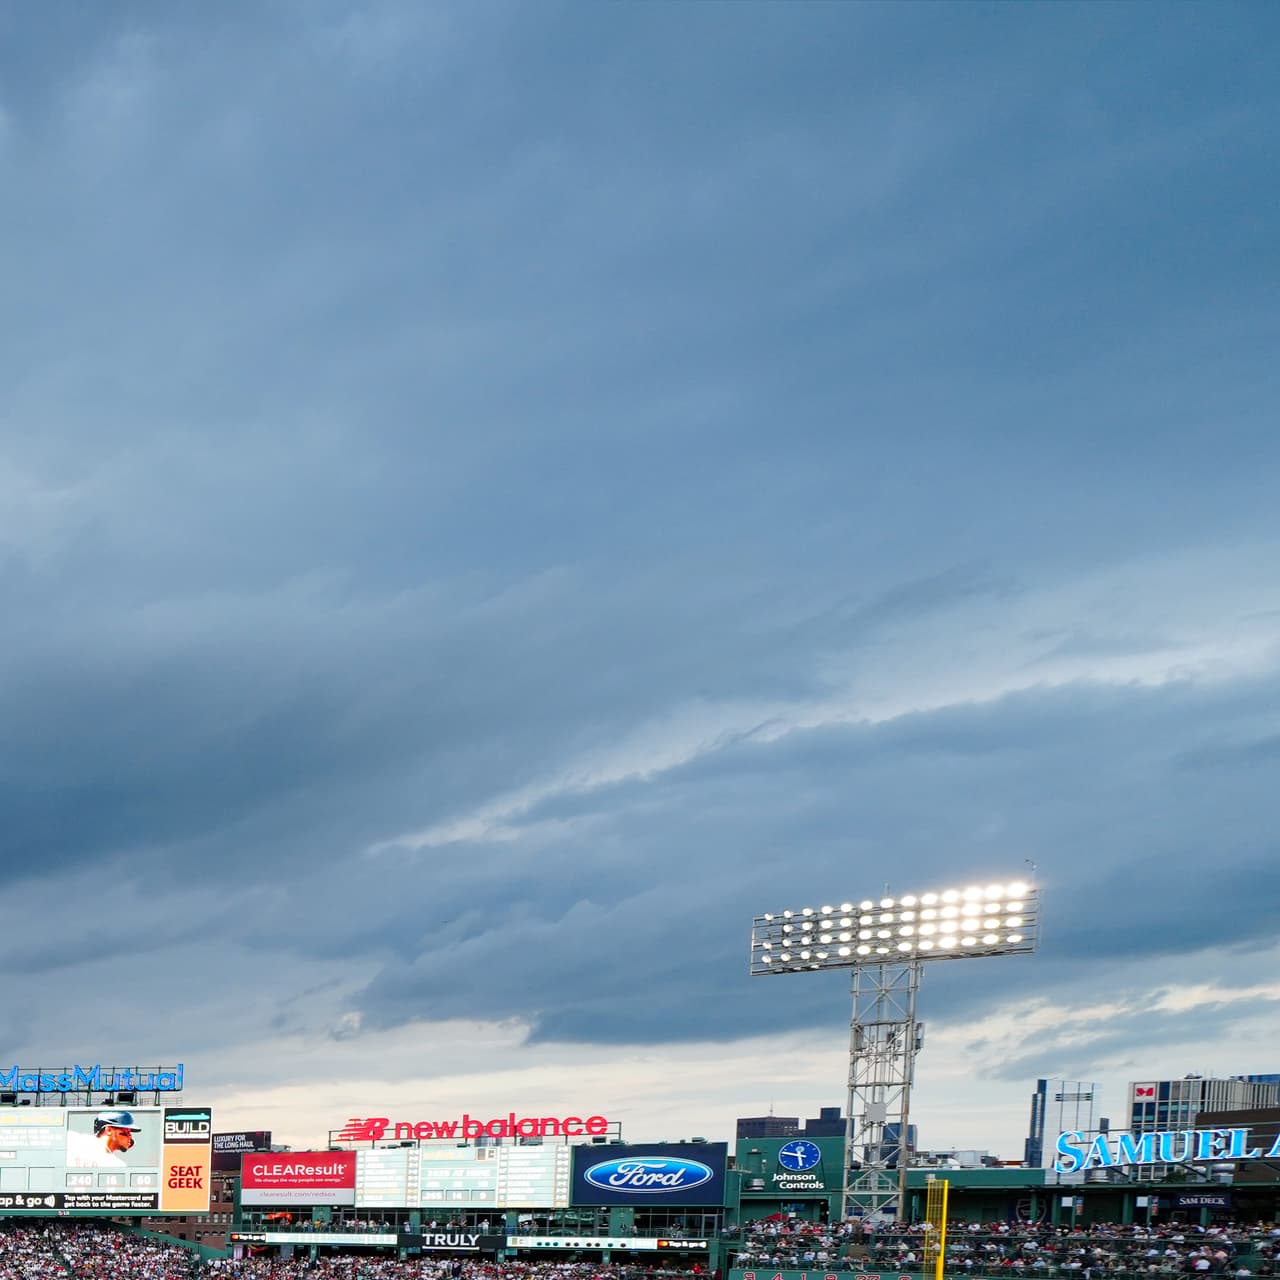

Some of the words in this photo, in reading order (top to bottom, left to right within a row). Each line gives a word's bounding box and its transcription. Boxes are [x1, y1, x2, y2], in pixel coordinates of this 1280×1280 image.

[165, 1122, 209, 1133] BUILD
[1054, 1128, 1259, 1173] SAMUEL
[171, 1165, 203, 1177] SEAT
[253, 1164, 344, 1176] CLEAResult
[609, 1162, 686, 1186] Ford
[772, 1173, 816, 1182] Johnson
[168, 1178, 203, 1189] GEEK
[779, 1181, 824, 1189] Controls
[16, 1195, 25, 1204] &
[27, 1197, 42, 1206] go
[1179, 1197, 1198, 1205] SAM
[1200, 1196, 1225, 1205] DECK
[422, 1234, 480, 1247] TRULY
